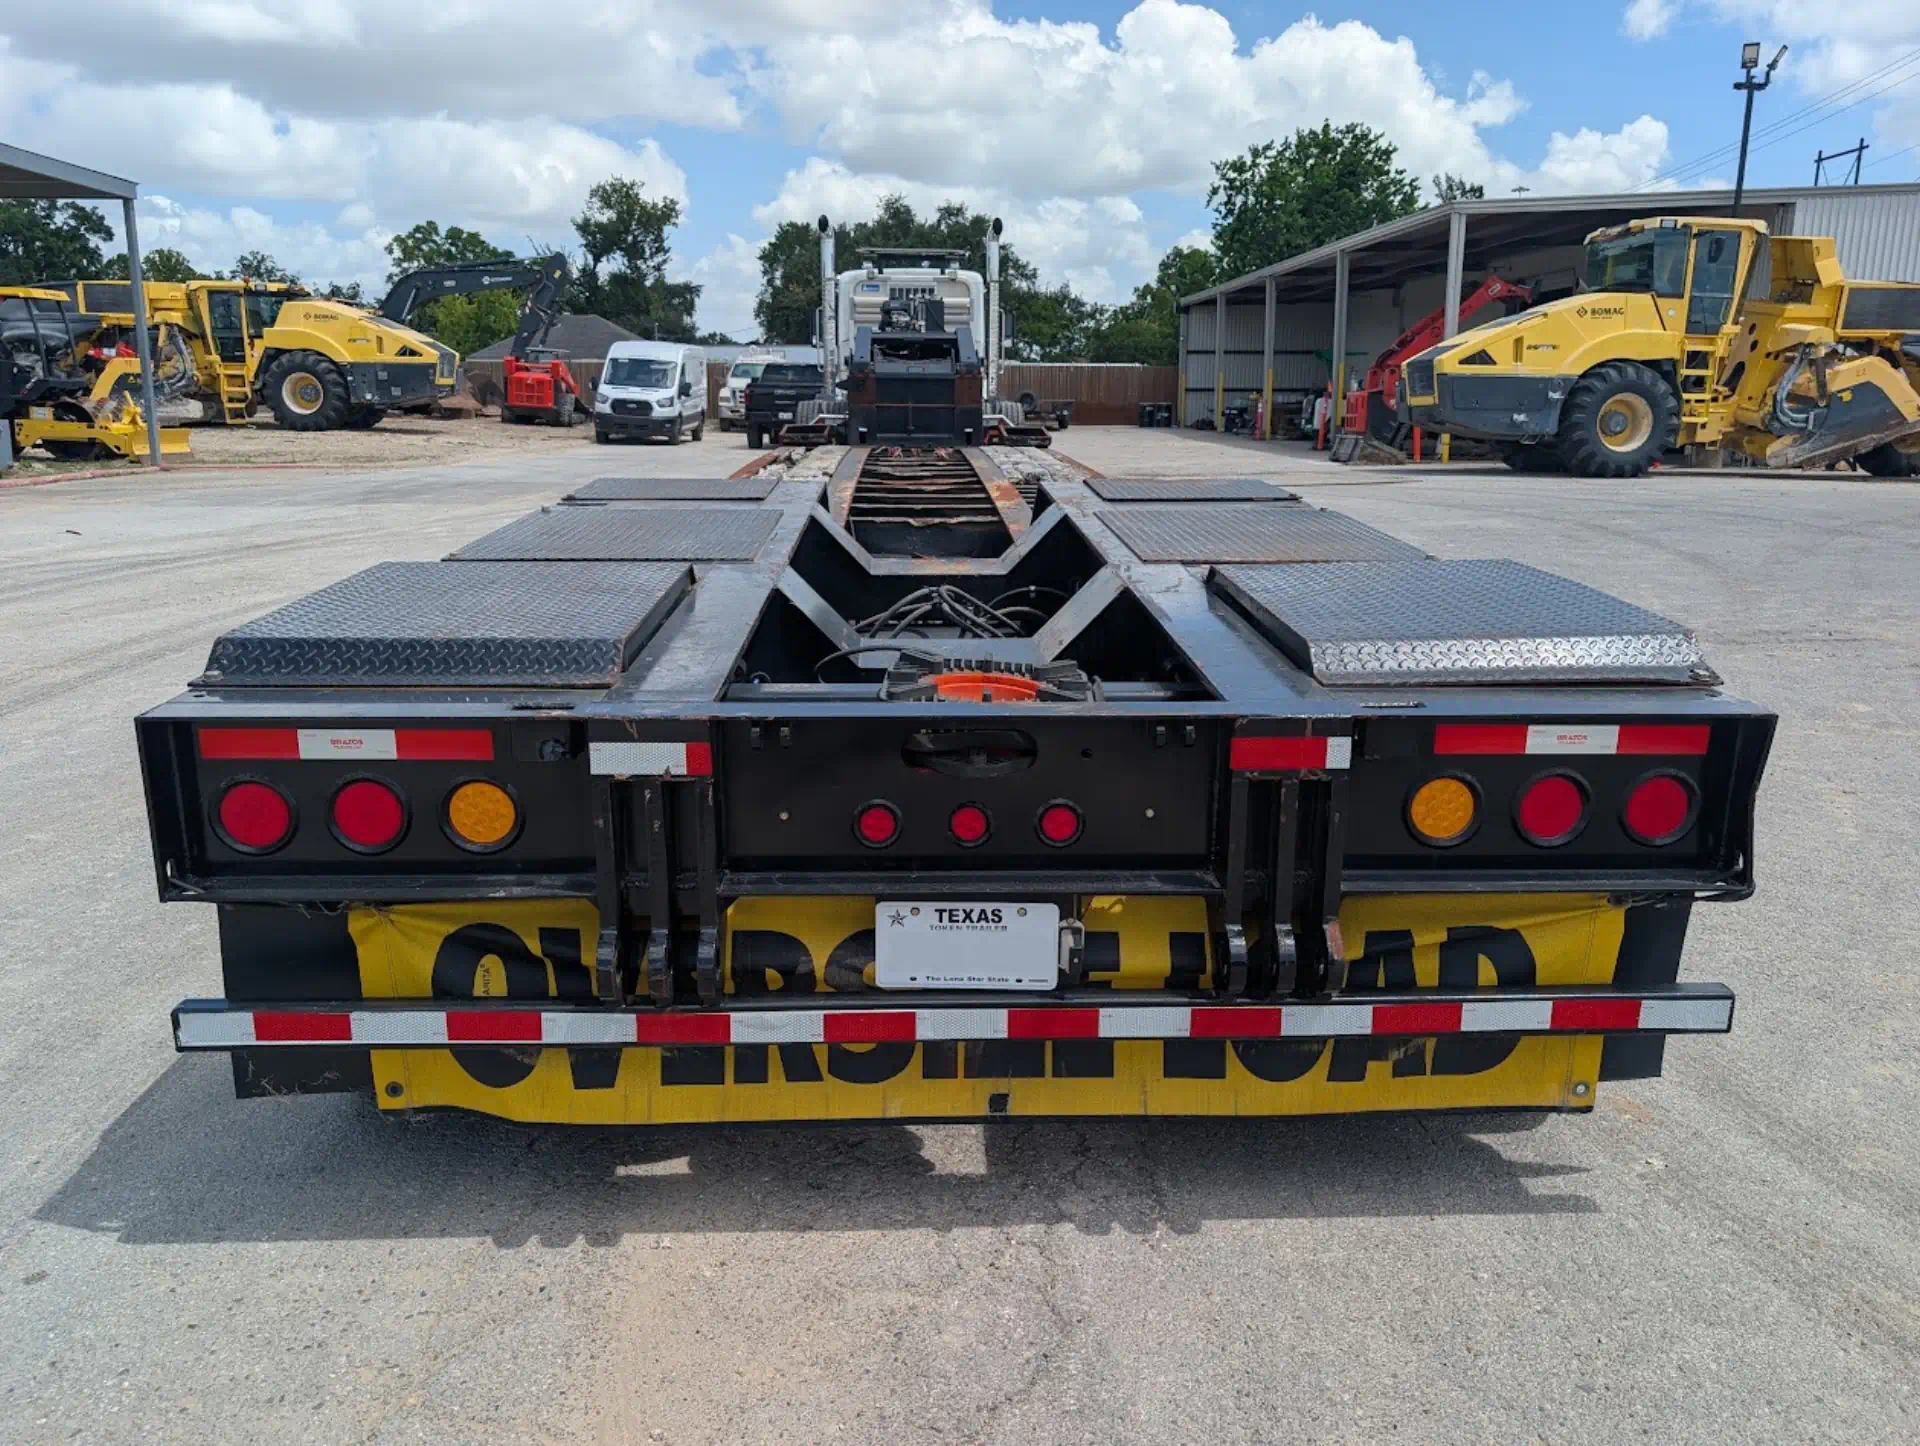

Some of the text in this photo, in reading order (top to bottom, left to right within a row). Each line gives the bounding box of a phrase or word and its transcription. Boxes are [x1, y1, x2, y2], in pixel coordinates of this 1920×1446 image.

[934, 908, 1003, 924] TEXAS
[929, 924, 1008, 932] TOKEN TRAILER
